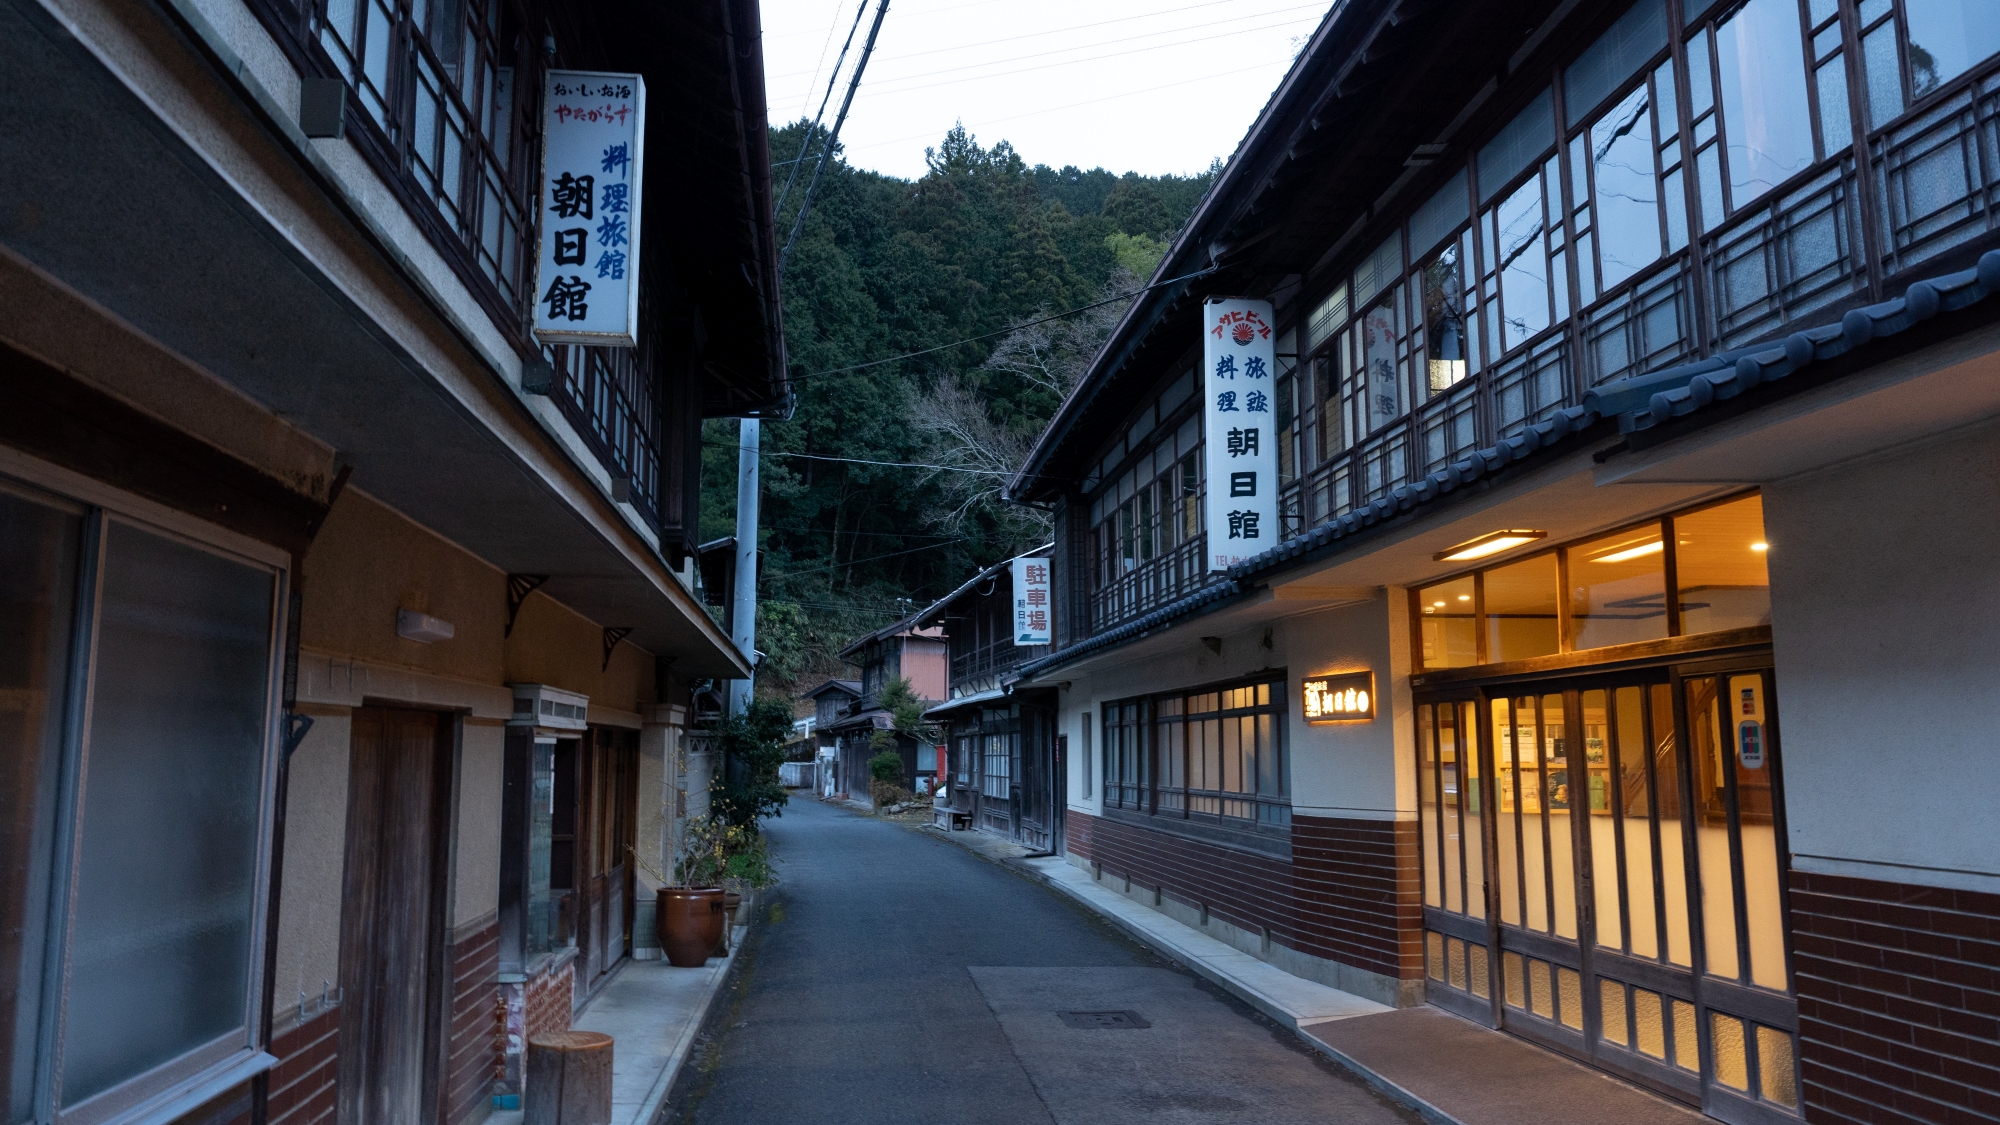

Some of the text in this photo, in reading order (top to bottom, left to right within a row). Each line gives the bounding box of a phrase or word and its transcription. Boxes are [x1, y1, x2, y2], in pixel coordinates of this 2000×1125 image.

[553, 83, 632, 99] おいしいお酒
[553, 103, 633, 127] やたがらす
[594, 140, 632, 281] 料理旅館
[541, 171, 595, 322] 朝日館
[1210, 309, 1272, 341] アサヒビール
[1215, 353, 1240, 413] 料理
[1226, 426, 1261, 540] 朝日館
[1215, 555, 1230, 567] TEL
[1025, 564, 1048, 631] 駐車場
